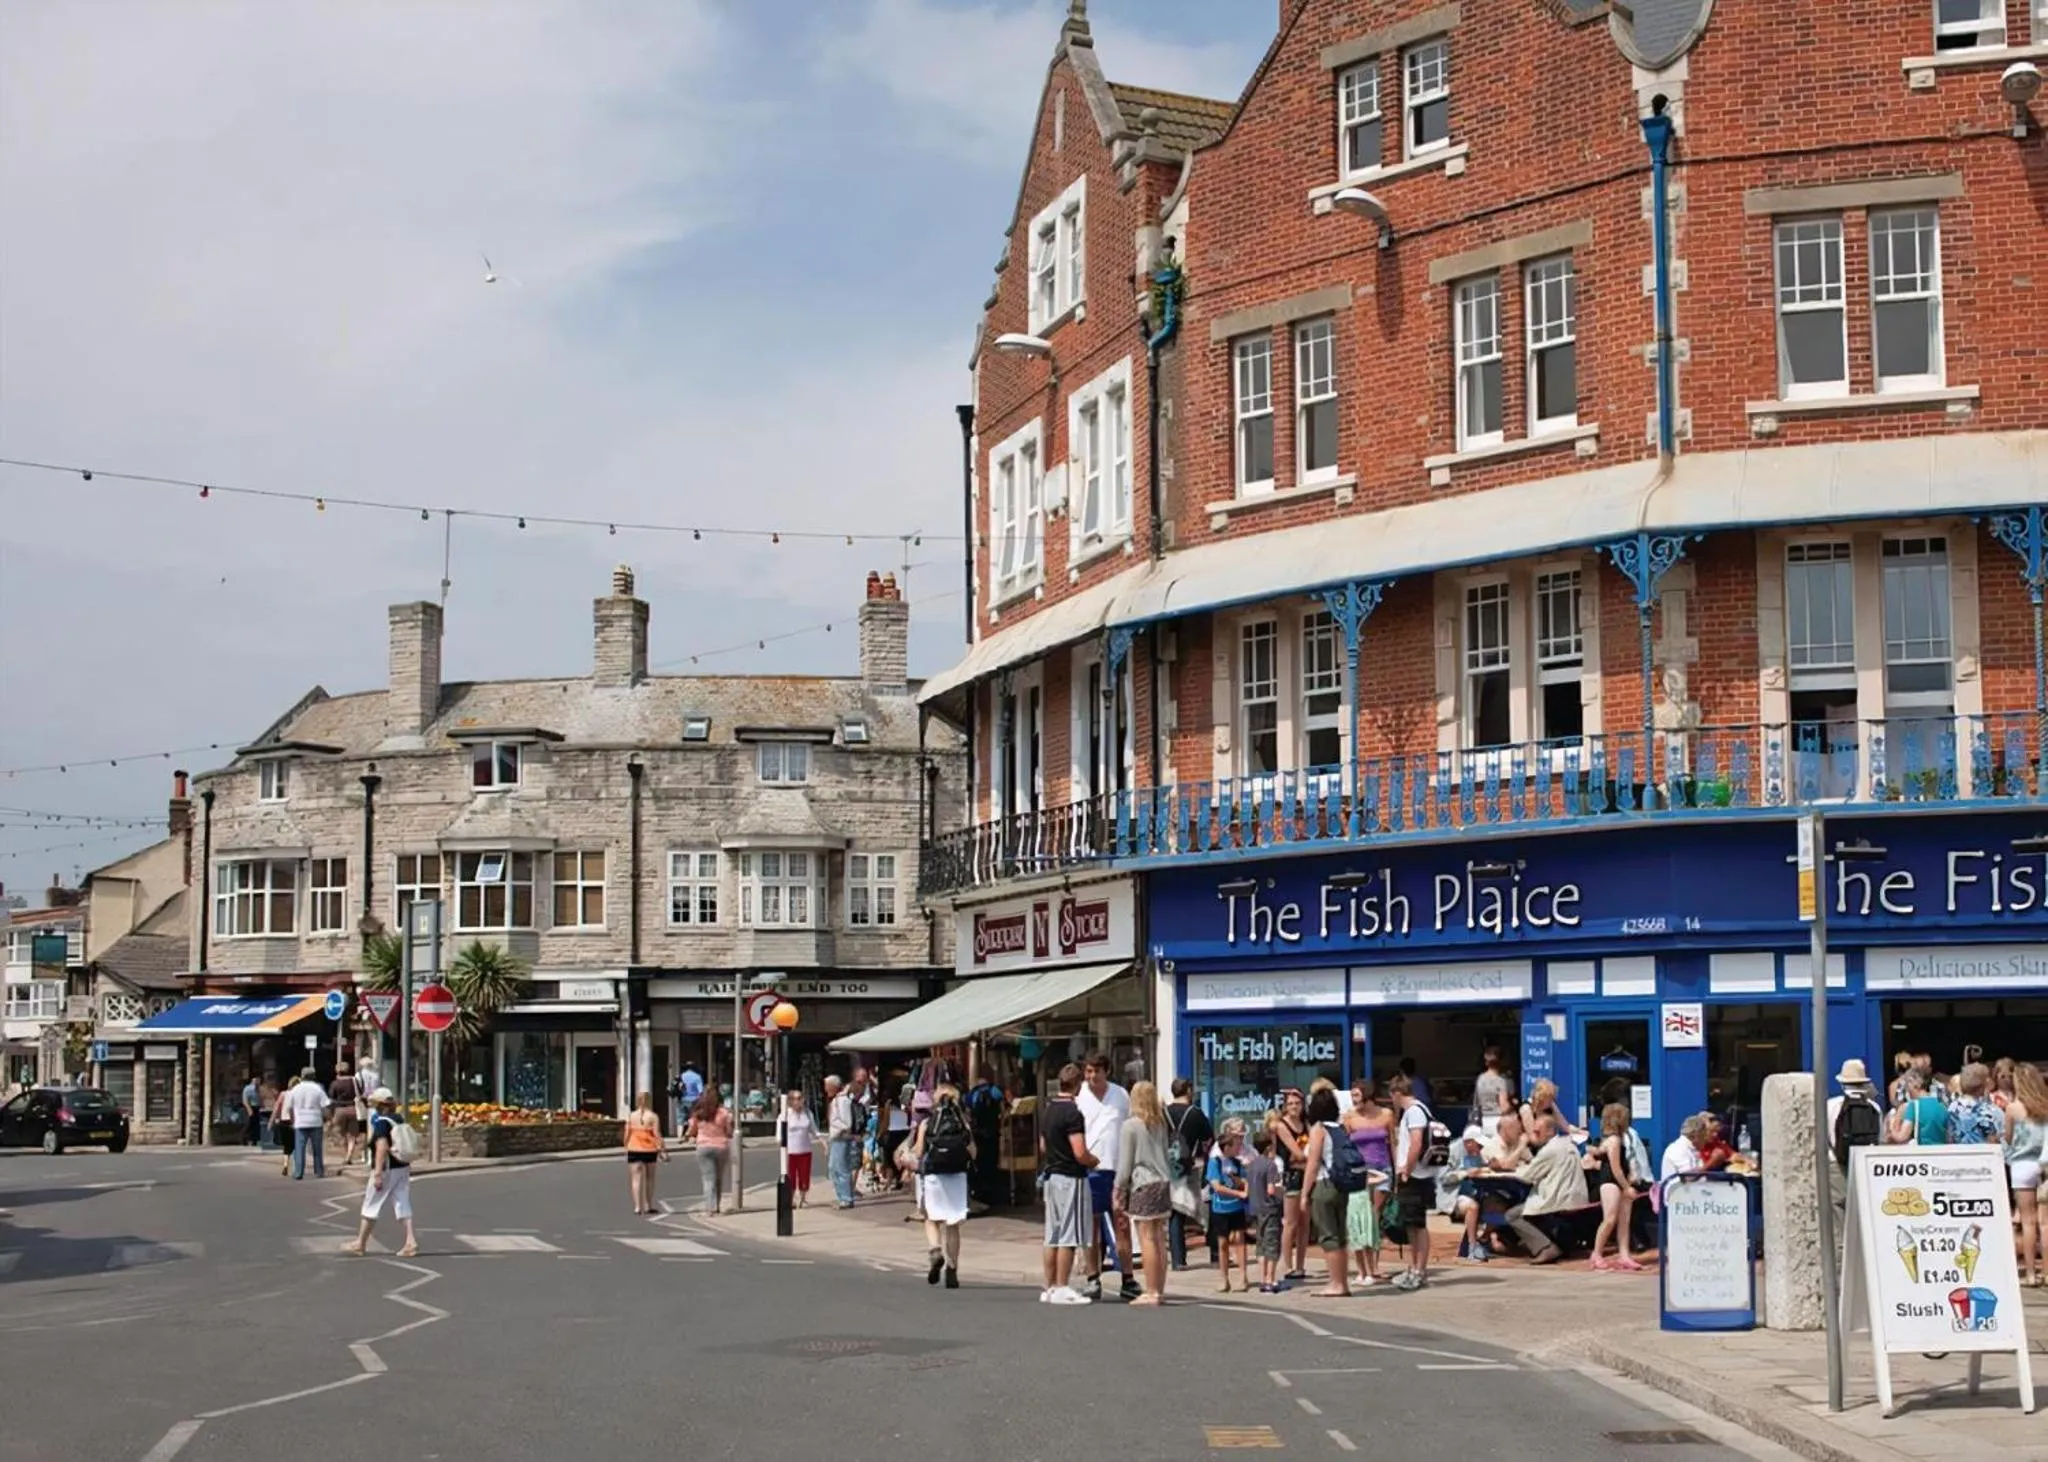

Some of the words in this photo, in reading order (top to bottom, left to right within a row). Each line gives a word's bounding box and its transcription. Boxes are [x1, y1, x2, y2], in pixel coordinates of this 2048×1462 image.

[1218, 878, 1300, 943] The
[1320, 868, 1409, 938] Fish
[1435, 860, 1580, 934] Plaice
[1900, 954, 2001, 979] Delicious
[1398, 970, 1465, 991] Boneless
[1469, 970, 1503, 992] Cod
[1200, 1033, 1234, 1060] The
[1239, 1032, 1275, 1060] Fish
[1281, 1032, 1335, 1062] Plaice
[1222, 1091, 1271, 1114] Quality
[1873, 1164, 1929, 1177] DINOS
[1675, 1200, 1700, 1215] Fish
[1704, 1200, 1739, 1216] Plaice
[1933, 1192, 1949, 1216] 5
[1920, 1239, 1956, 1252] £1.20
[1923, 1270, 1960, 1283] £1.40
[1896, 1303, 1944, 1317] Slush
